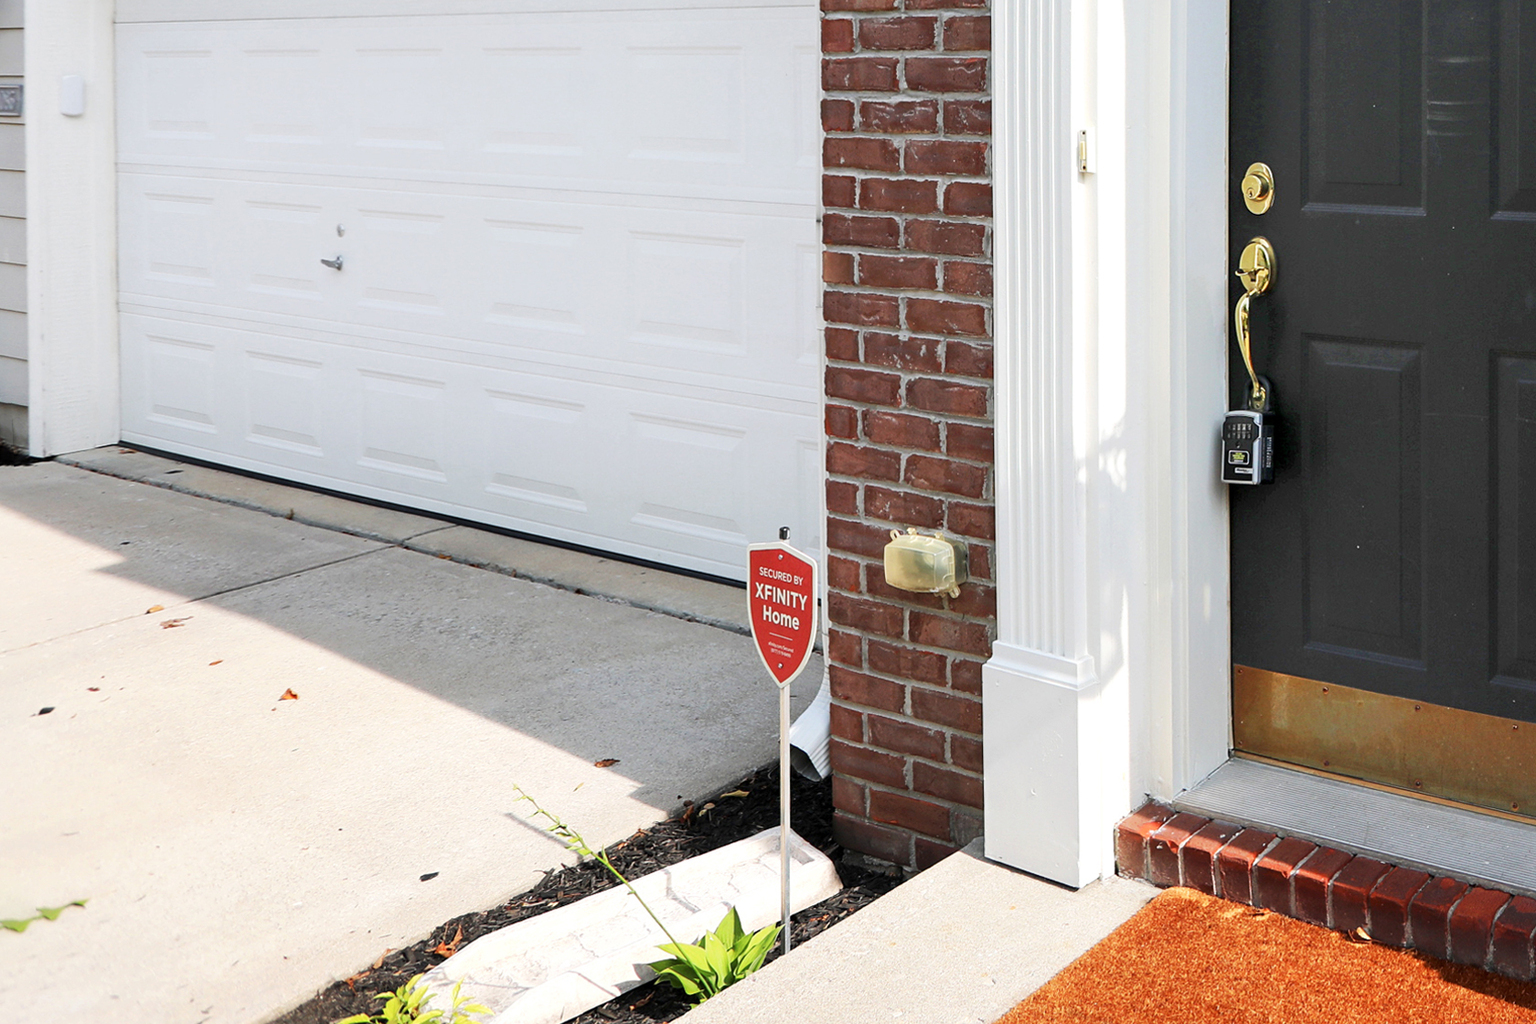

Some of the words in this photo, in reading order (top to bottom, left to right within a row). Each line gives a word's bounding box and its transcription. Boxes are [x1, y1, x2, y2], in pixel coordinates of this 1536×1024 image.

[759, 566, 792, 583] SECURED
[793, 574, 804, 586] BY
[755, 582, 808, 611] XFINITY
[763, 605, 800, 631] Home
